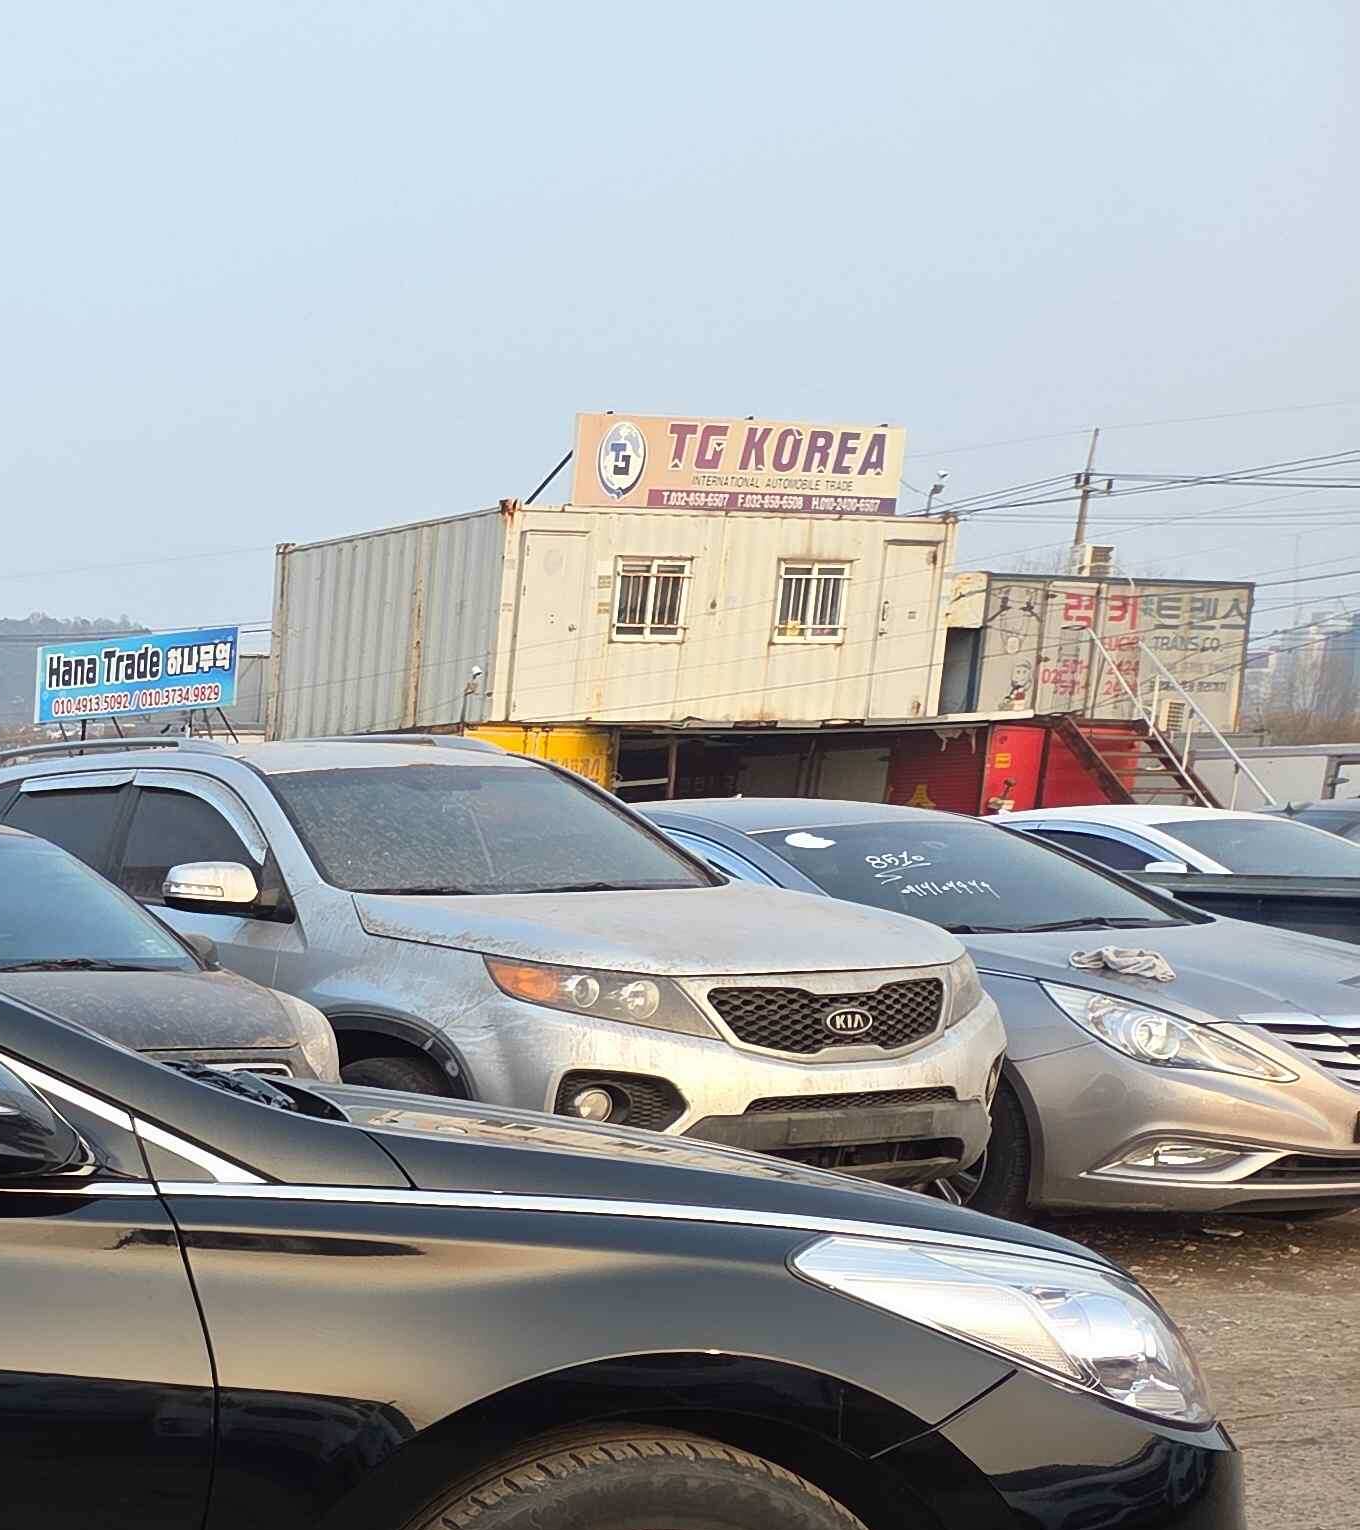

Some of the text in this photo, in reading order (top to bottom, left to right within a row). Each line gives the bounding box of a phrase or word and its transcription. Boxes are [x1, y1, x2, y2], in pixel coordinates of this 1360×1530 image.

[668, 422, 889, 476] TG KOREA
[692, 474, 854, 492] INTERNATIONAL AUTOMOBILE TRADE
[47, 641, 232, 690] Hana Trade 하나무역
[834, 1013, 865, 1030] KIA
